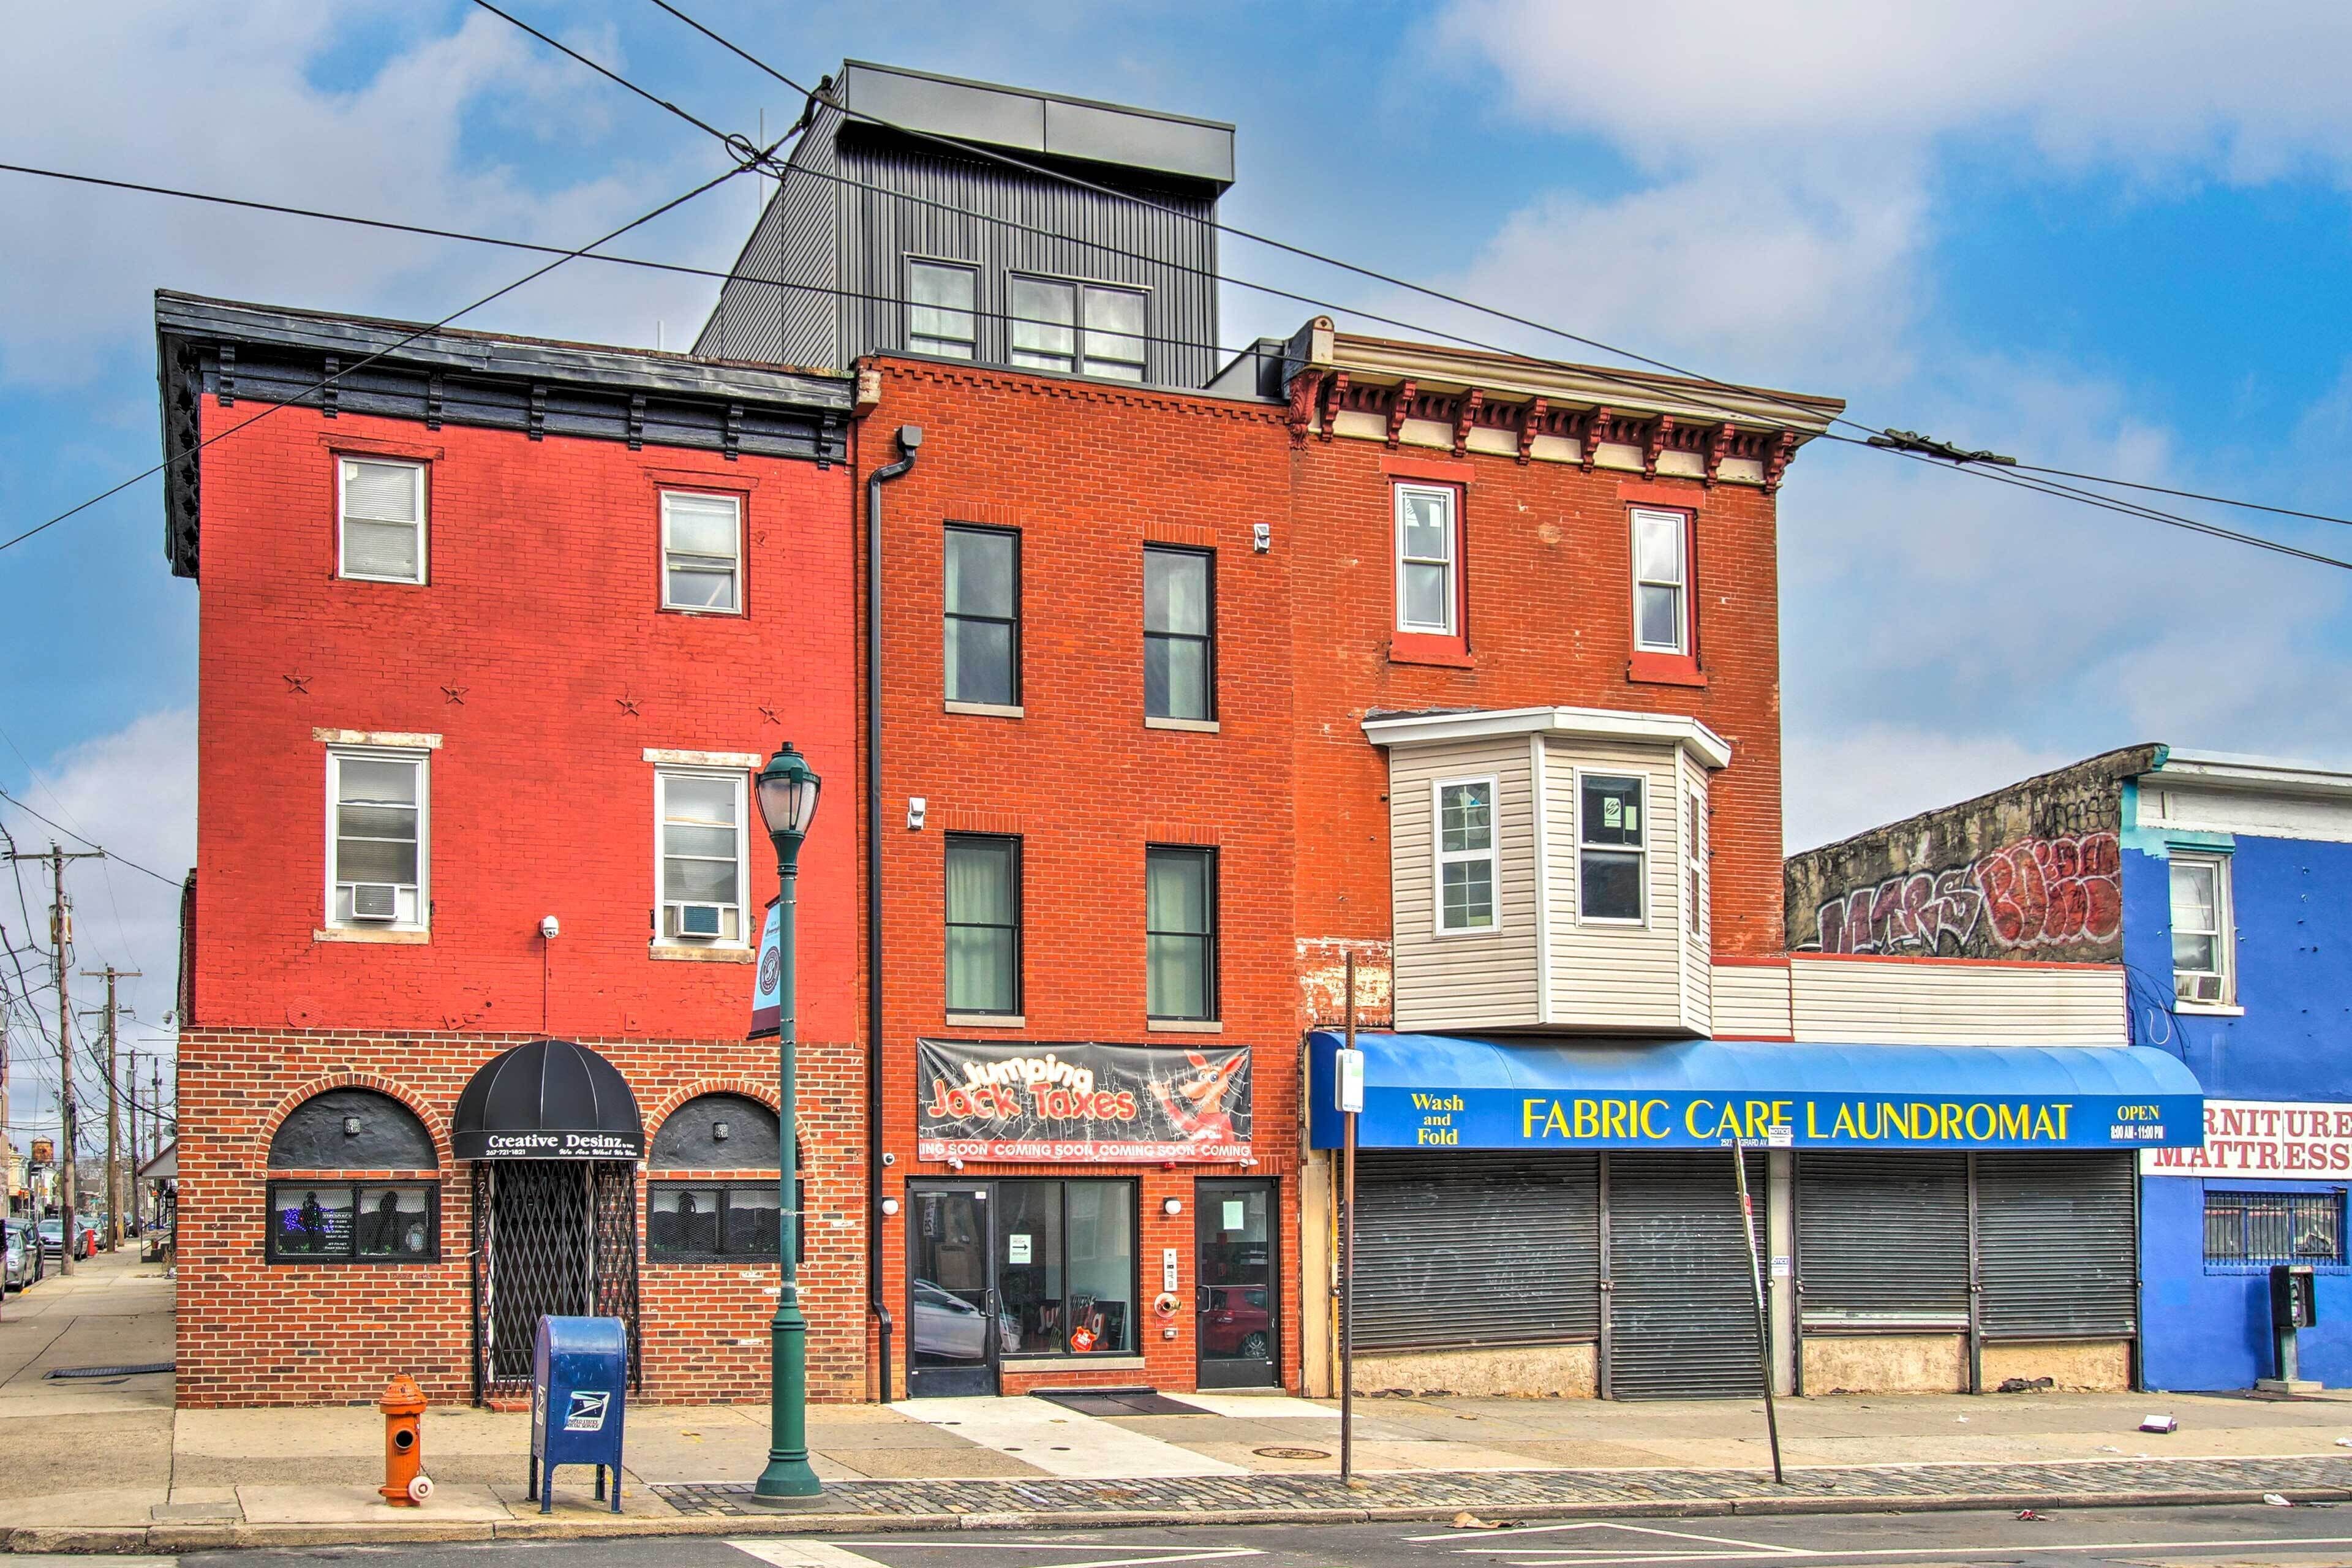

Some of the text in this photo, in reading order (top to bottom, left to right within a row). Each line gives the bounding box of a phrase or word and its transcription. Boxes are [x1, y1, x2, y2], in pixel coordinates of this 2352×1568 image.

[963, 1054, 1094, 1094] Jumping
[927, 1079, 1137, 1121] Jack Taxes
[1411, 1093, 1464, 1111] Wash
[1423, 1114, 1452, 1126] and
[1523, 1099, 2073, 1140] FABRIC CARE LAUNDROMAT
[2117, 1105, 2160, 1121] OPEN
[1417, 1128, 1459, 1145] Fold
[2111, 1125, 2124, 1139] 8:00
[2124, 1125, 2133, 1139] AM
[2138, 1125, 2154, 1139] 11:00
[2154, 1125, 2163, 1139] PM
[489, 1134, 559, 1148] Creative
[566, 1134, 622, 1148] Desinz
[1740, 1139, 1759, 1147] GIRARD
[948, 1144, 988, 1155] SOON
[995, 1144, 1052, 1156] COMING
[1054, 1144, 1093, 1156] SOON
[1099, 1144, 1153, 1156] COMING
[1156, 1144, 1195, 1156] SOON
[1200, 1145, 1250, 1157] COMING
[2154, 1140, 2352, 1170] MATTRESS
